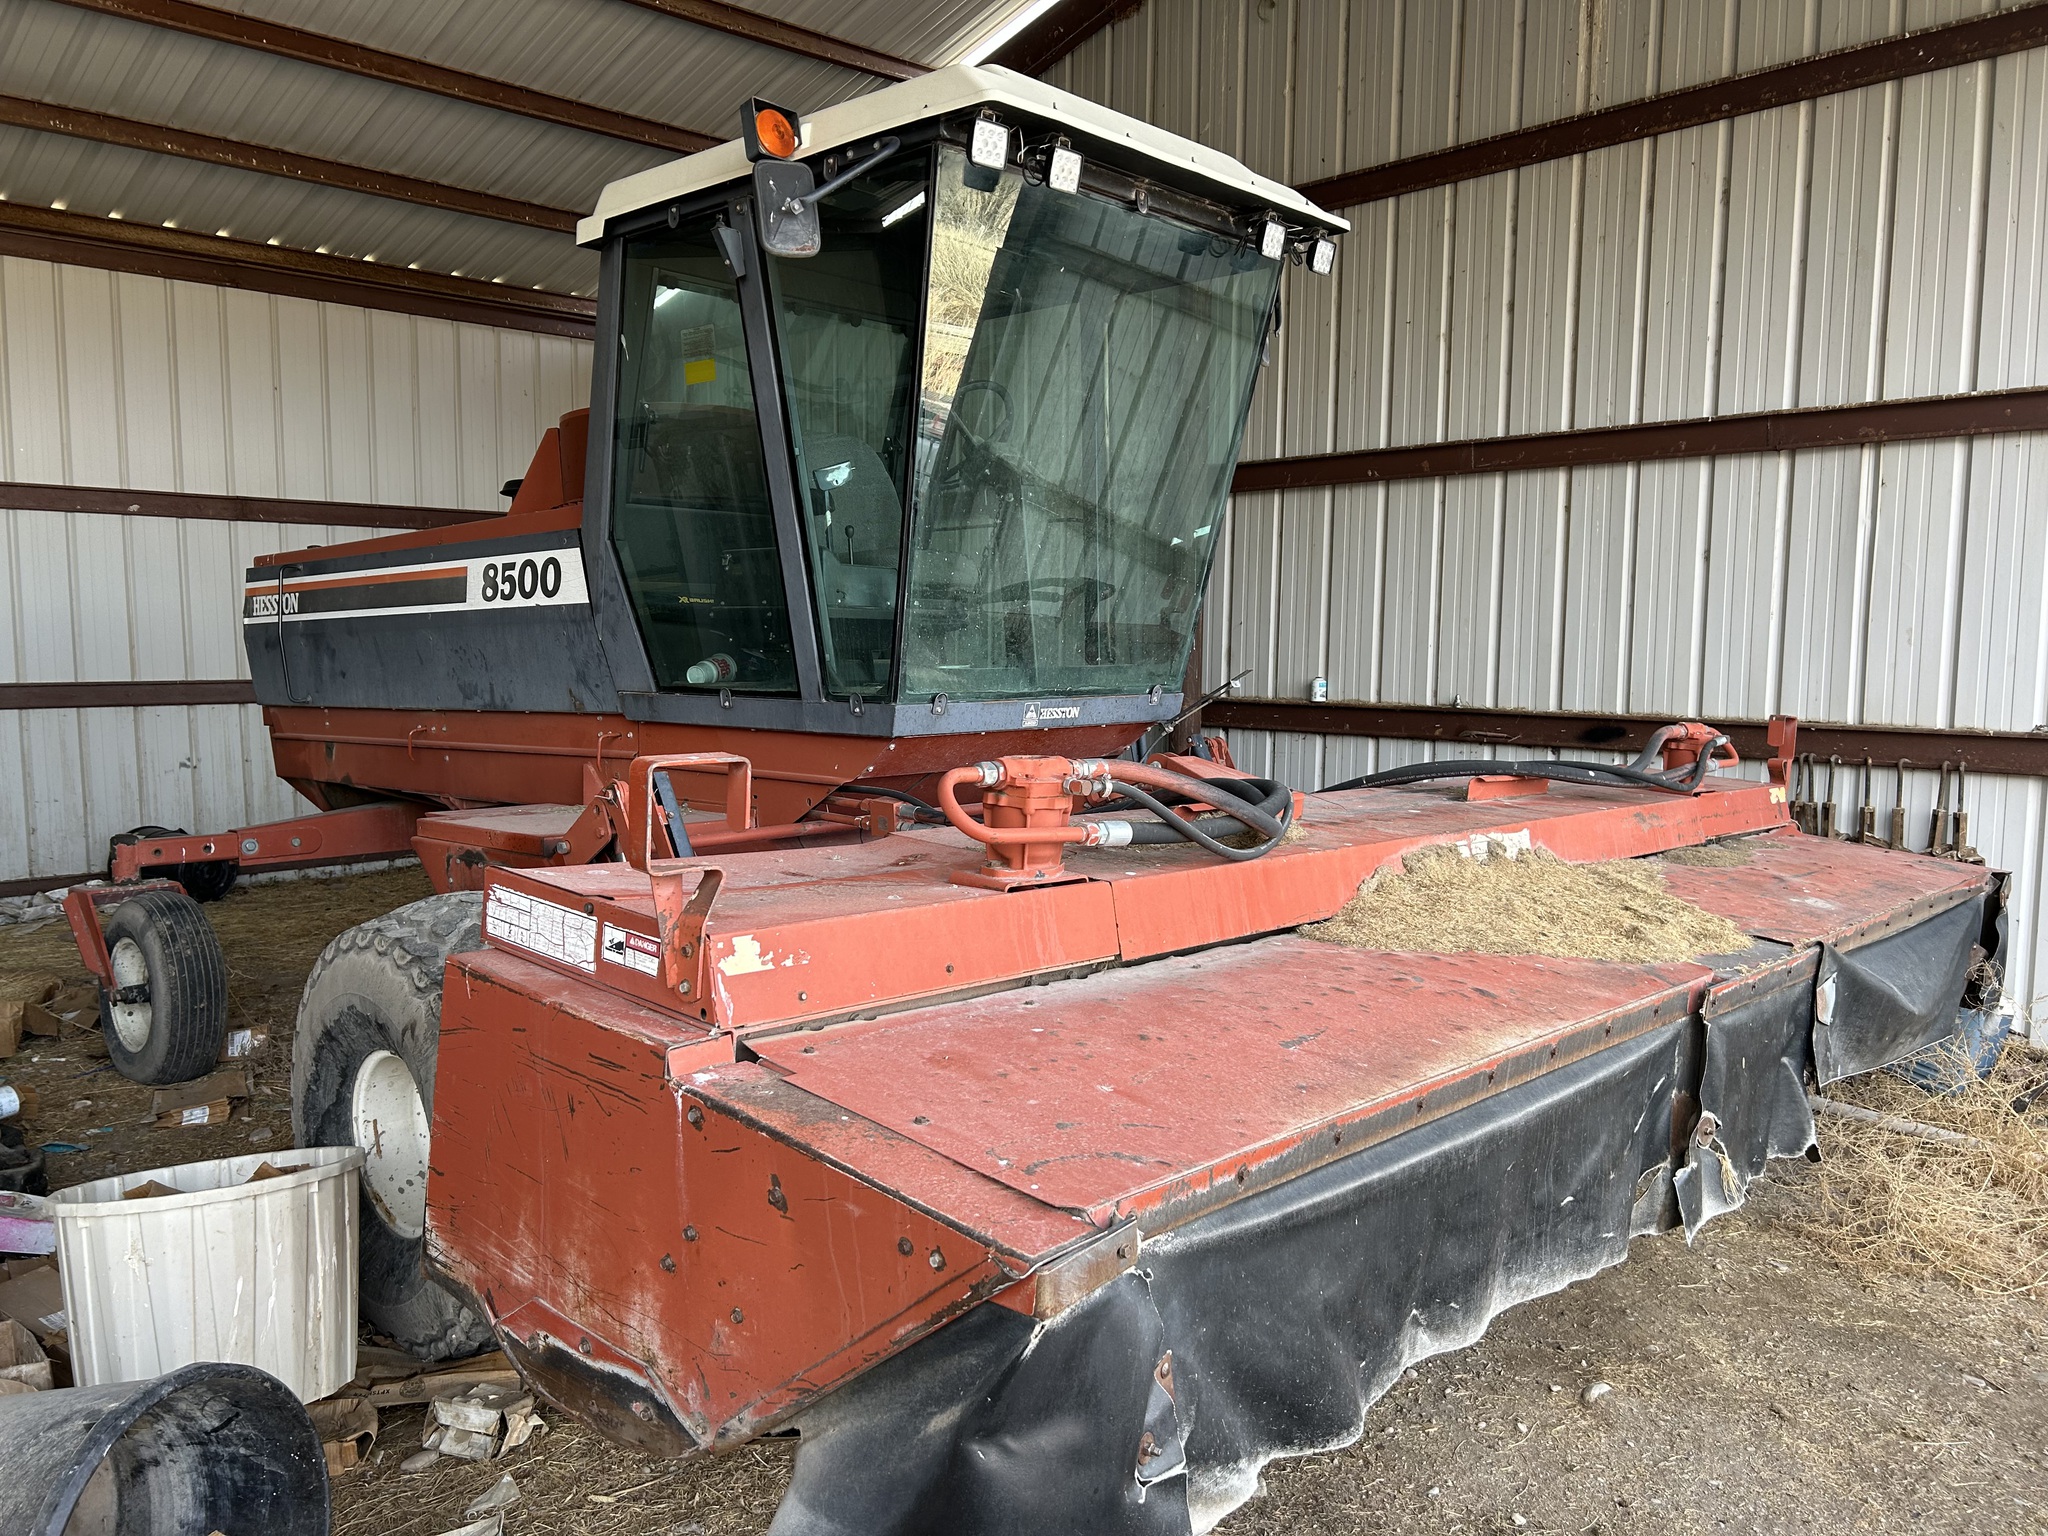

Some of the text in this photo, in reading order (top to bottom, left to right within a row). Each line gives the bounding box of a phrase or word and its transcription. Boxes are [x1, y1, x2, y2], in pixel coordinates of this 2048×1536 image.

[481, 556, 562, 603] 8500
[253, 592, 299, 616] HESSON
[1040, 706, 1080, 719] HESSTON
[635, 938, 657, 953] DANGER
